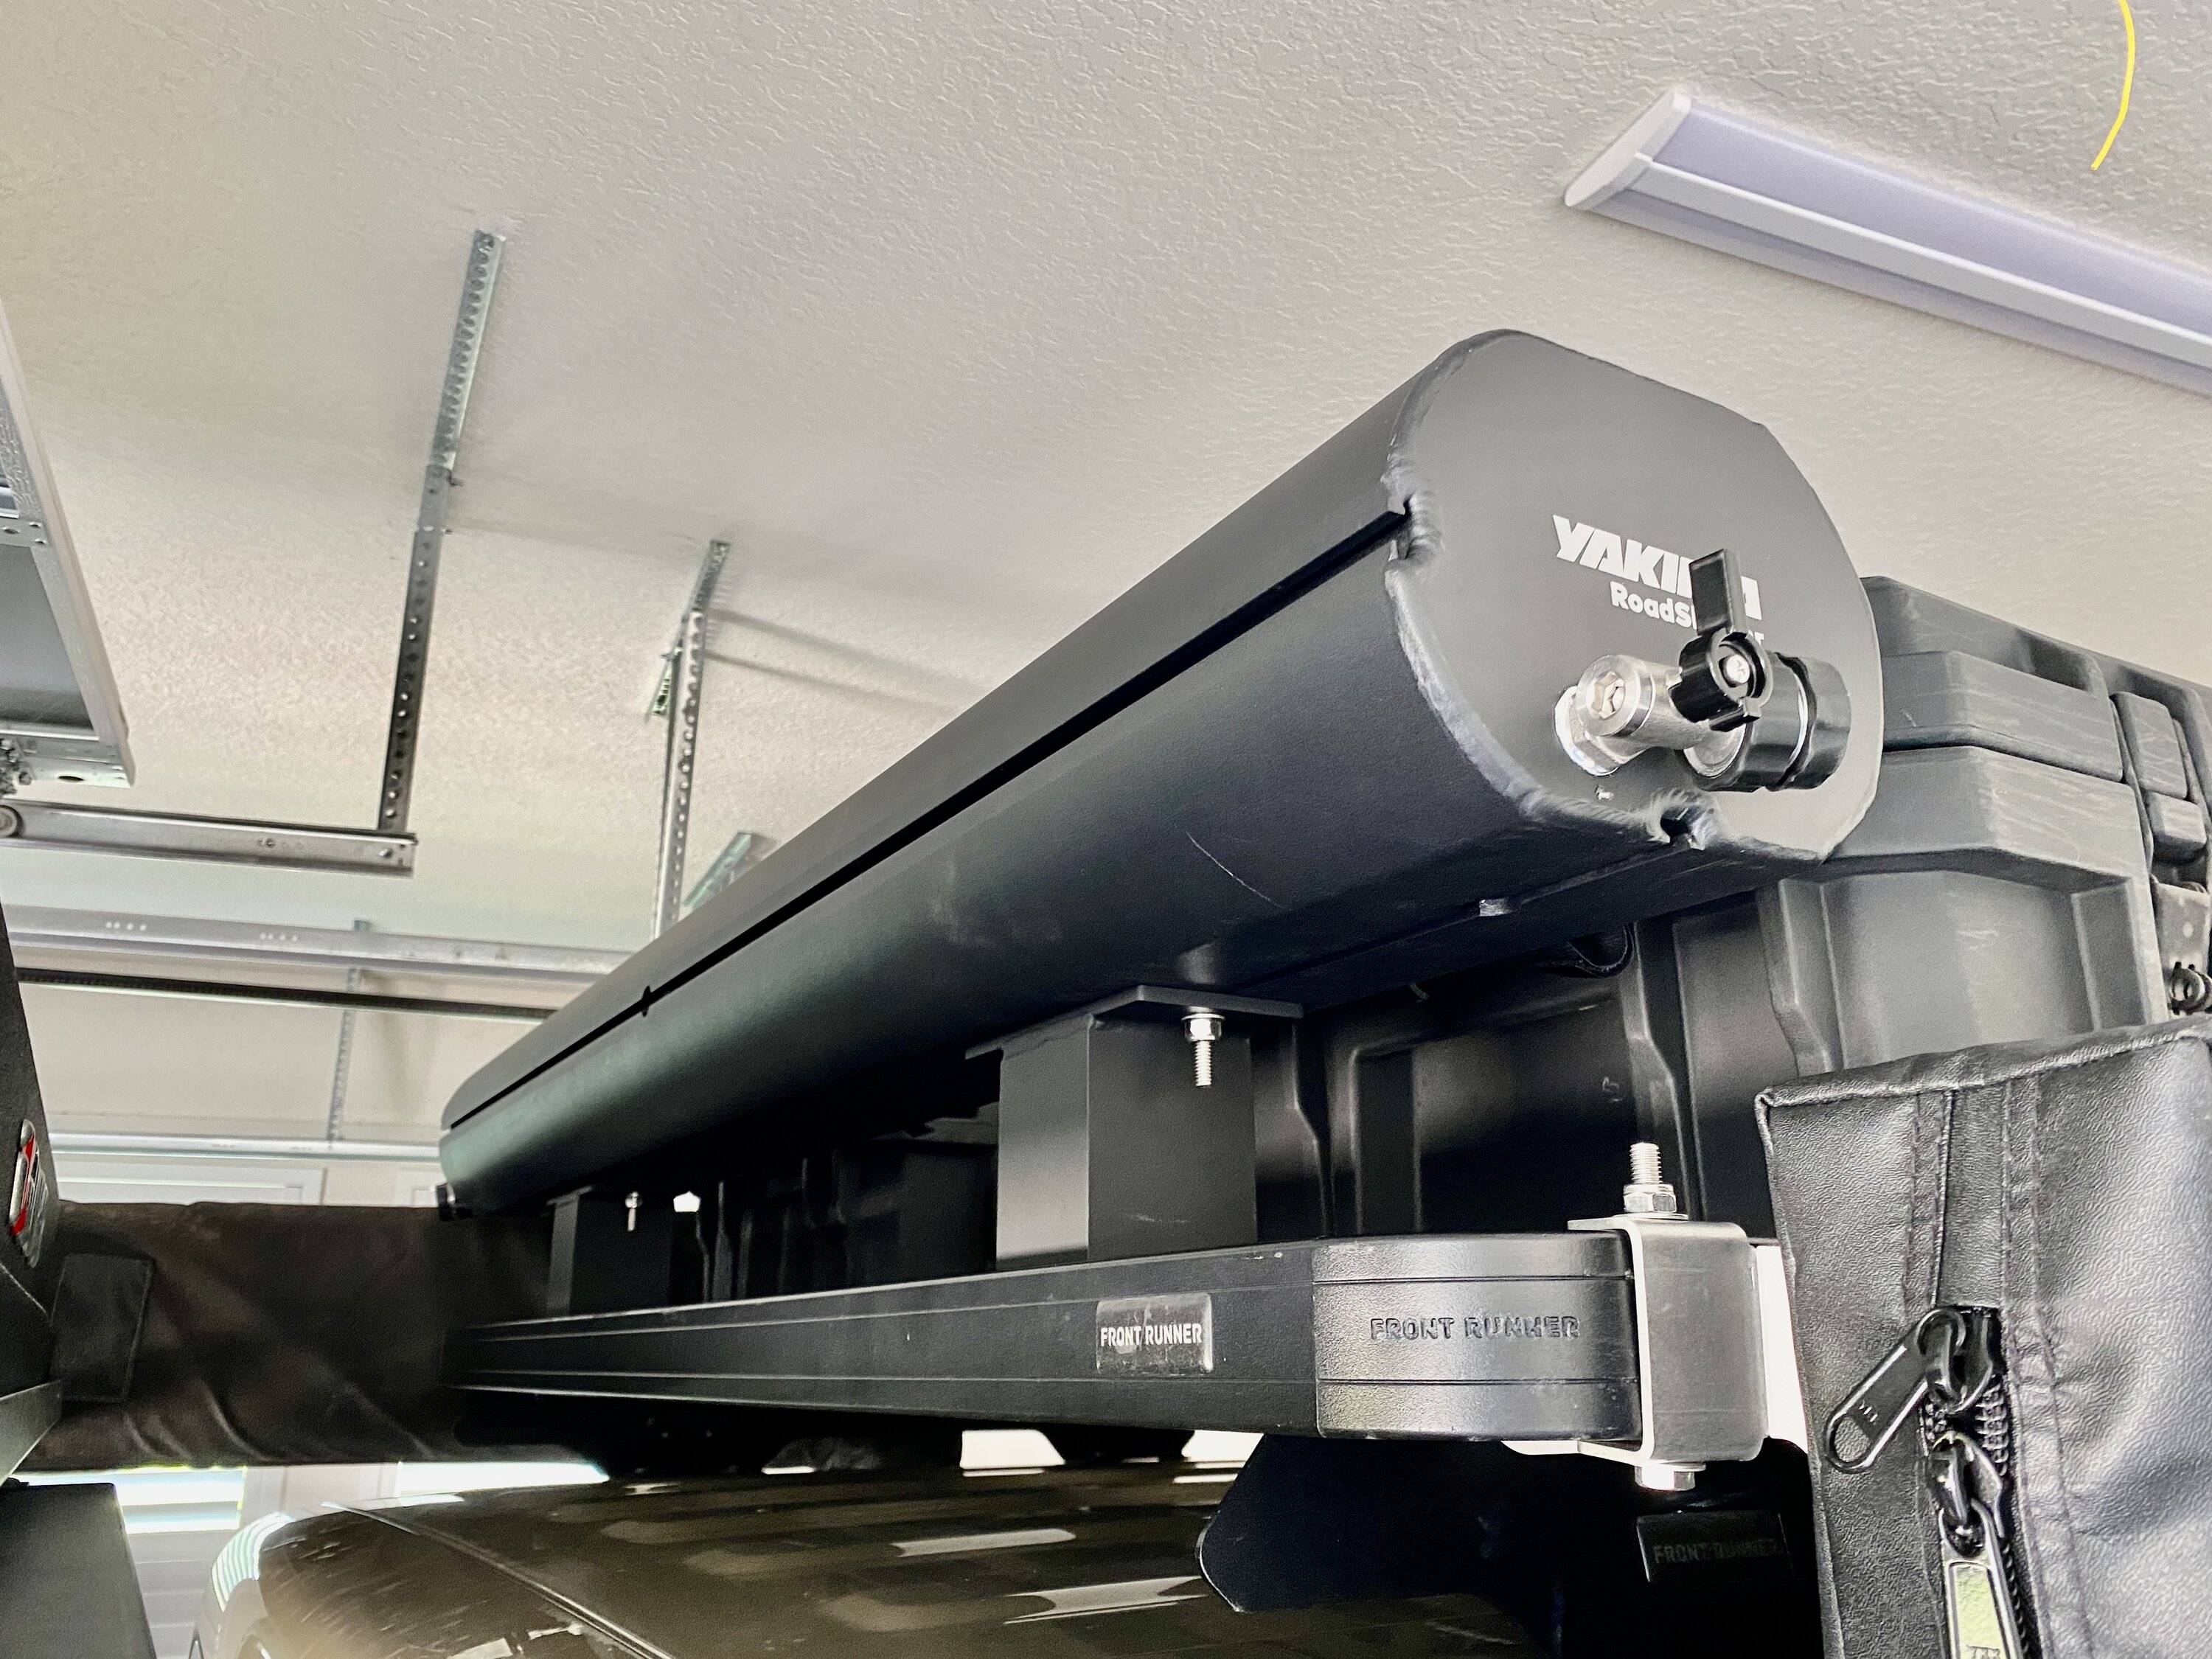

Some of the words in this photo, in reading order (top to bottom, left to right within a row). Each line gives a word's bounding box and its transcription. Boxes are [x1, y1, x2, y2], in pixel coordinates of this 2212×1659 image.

[1552, 514, 1762, 621] YAKIA
[1099, 1326, 1142, 1348] FRONT
[1144, 1323, 1203, 1346] RUNNER
[1370, 1316, 1455, 1340] FRONT
[1463, 1315, 1579, 1339] RUNNER
